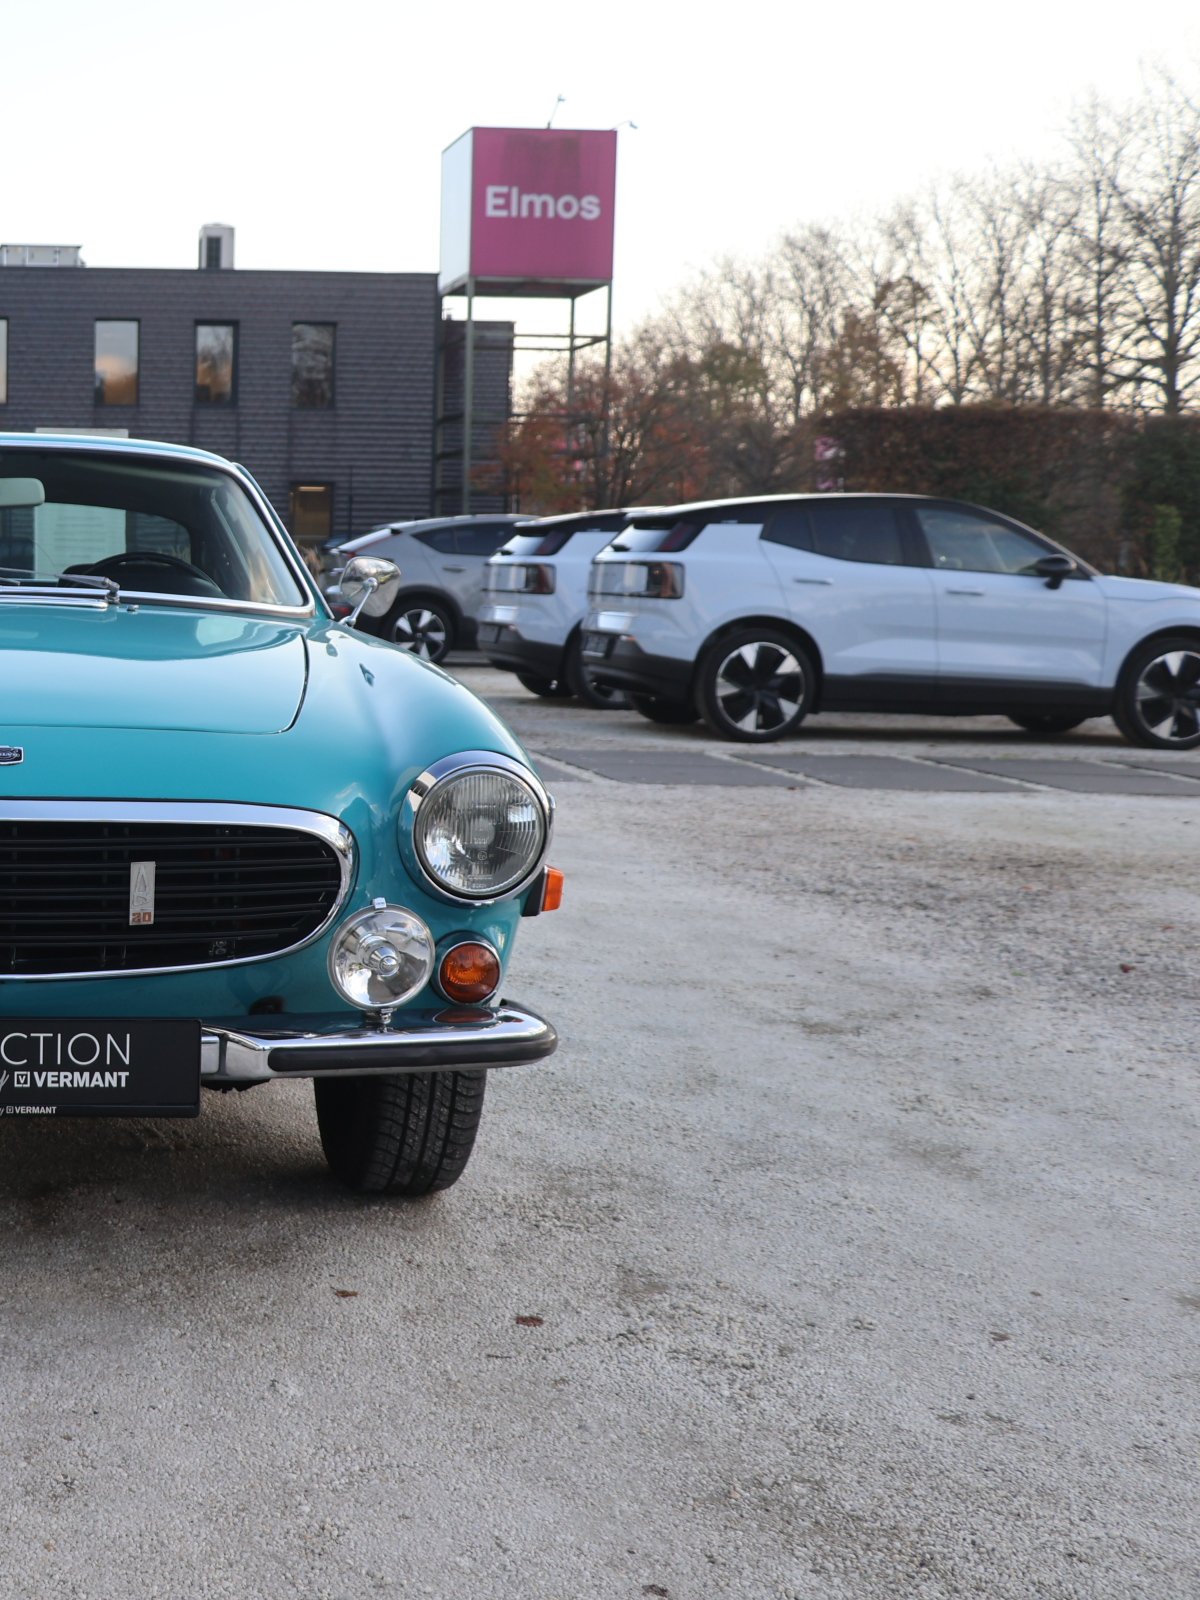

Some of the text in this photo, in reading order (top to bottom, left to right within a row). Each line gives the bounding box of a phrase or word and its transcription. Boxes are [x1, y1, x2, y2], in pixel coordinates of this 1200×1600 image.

[485, 185, 601, 220] Elmos
[33, 1071, 130, 1088] VERMANT
[14, 1105, 58, 1115] VERMANT
